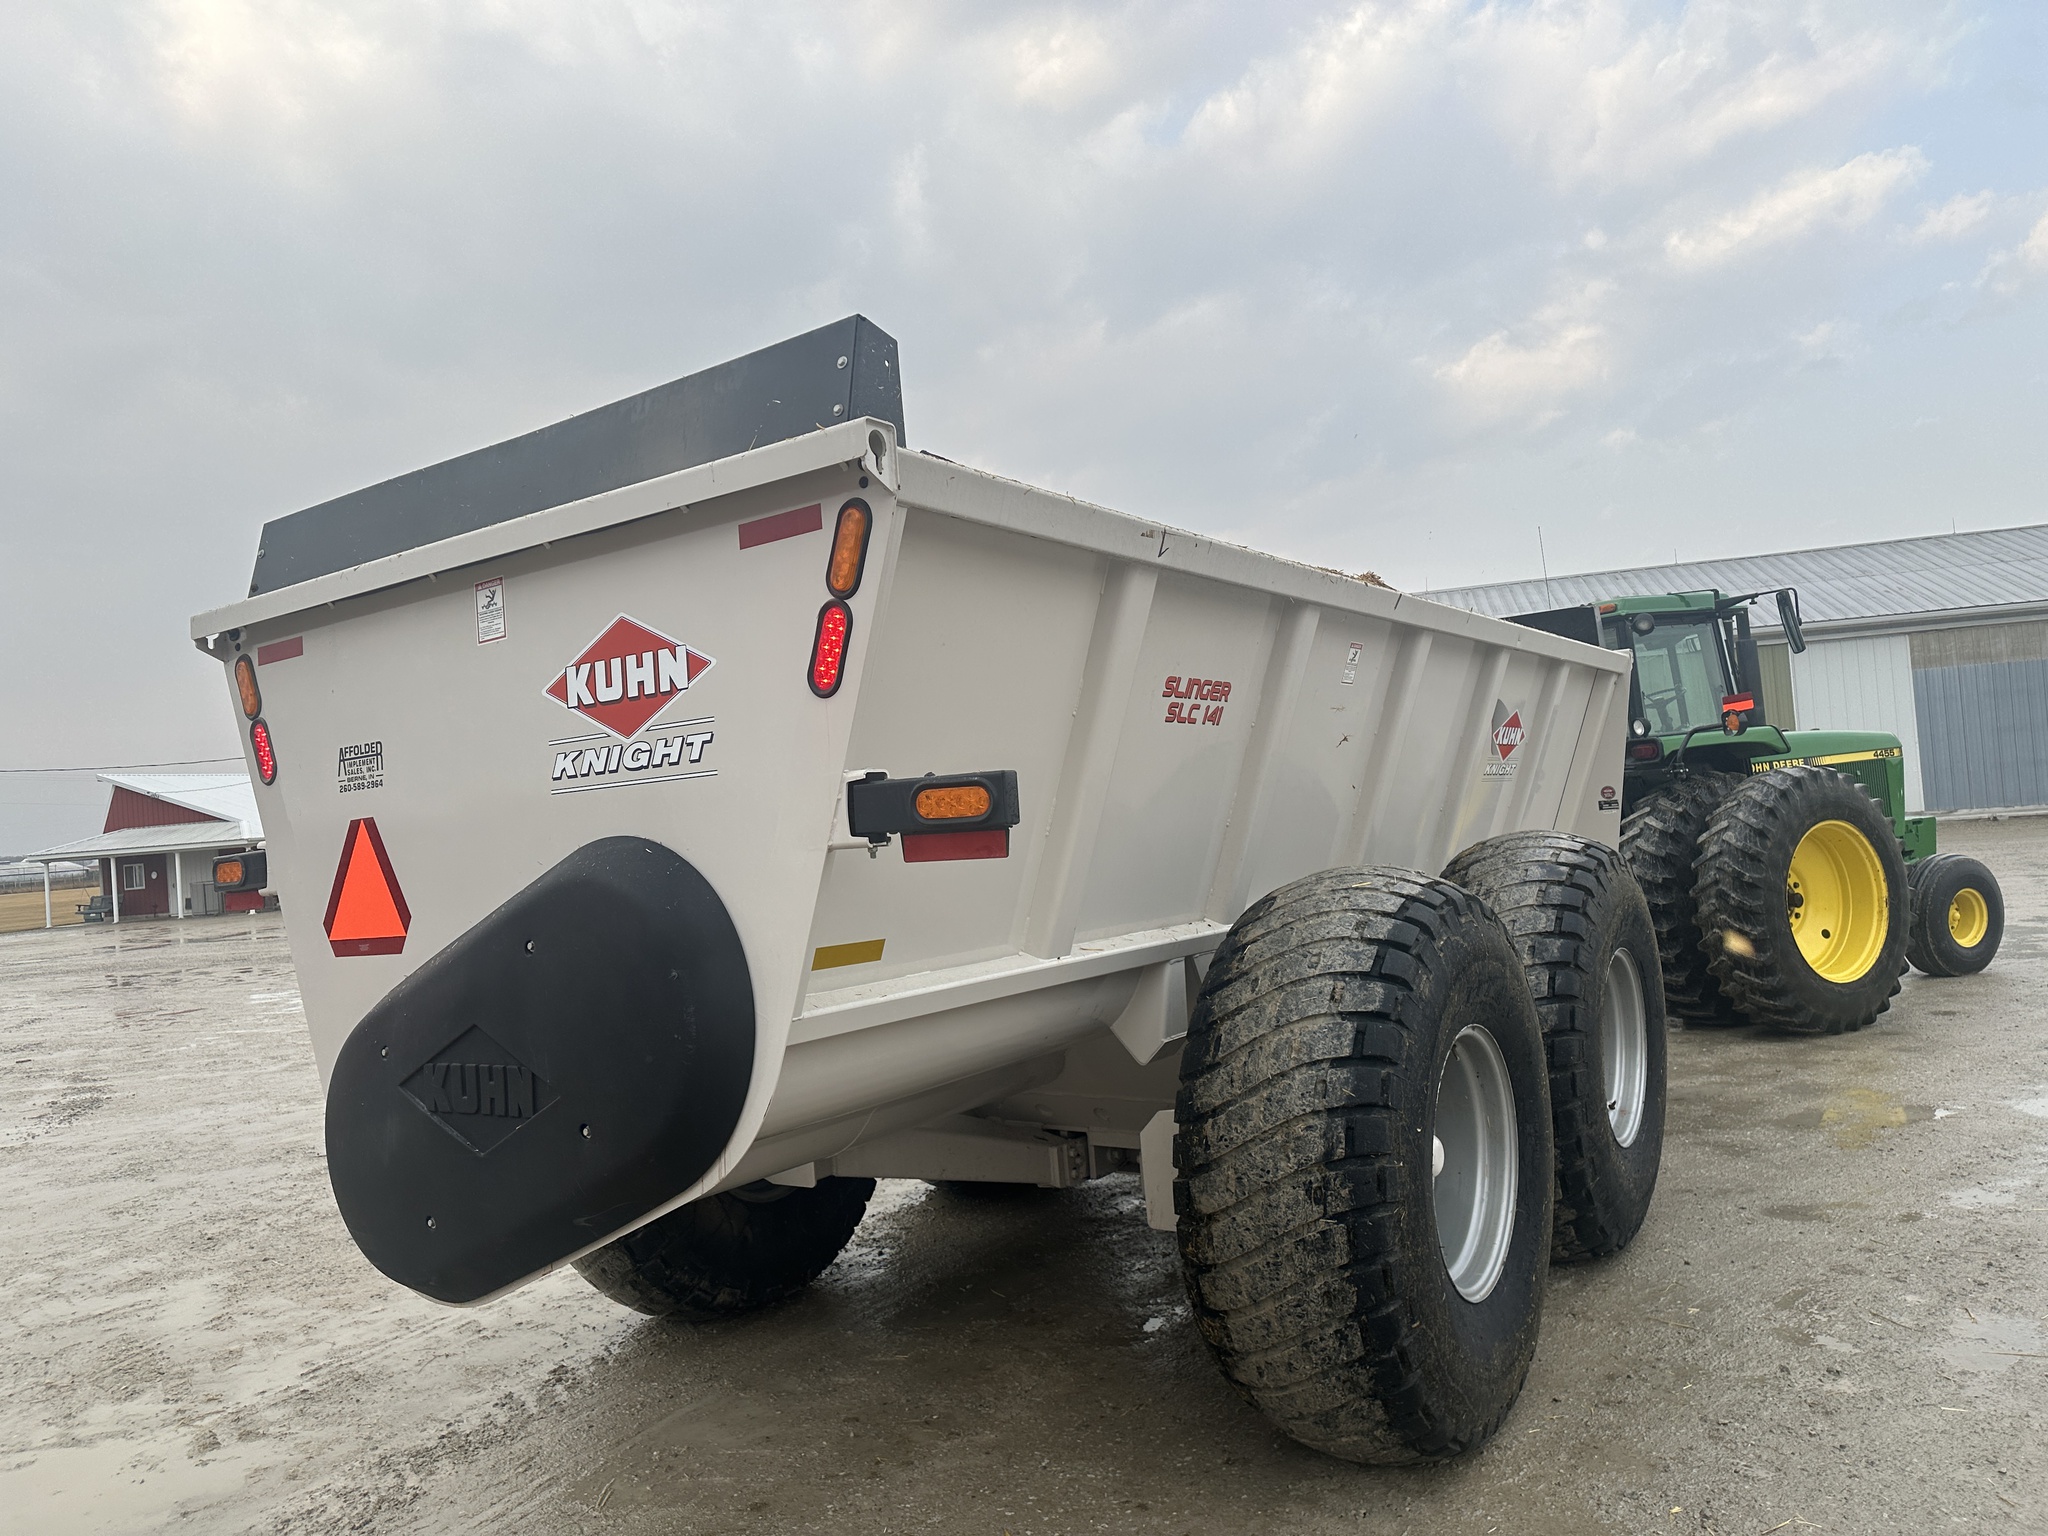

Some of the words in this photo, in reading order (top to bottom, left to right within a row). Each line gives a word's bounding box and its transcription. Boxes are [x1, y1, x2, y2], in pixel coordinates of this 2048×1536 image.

[565, 644, 689, 709] KUHN
[1162, 676, 1232, 702] SLINGER
[1165, 702, 1201, 724] SLC
[1202, 705, 1224, 726] 141
[1496, 726, 1523, 746] KUHN
[338, 741, 384, 777] AFFOLDER
[347, 757, 375, 768] IMPLEMENT
[552, 731, 714, 781] KNIGHT
[1773, 758, 1805, 769] DEERE
[1873, 750, 1895, 758] 4455
[1483, 764, 1517, 776] KNIGHT
[423, 1063, 534, 1119] KUHN
